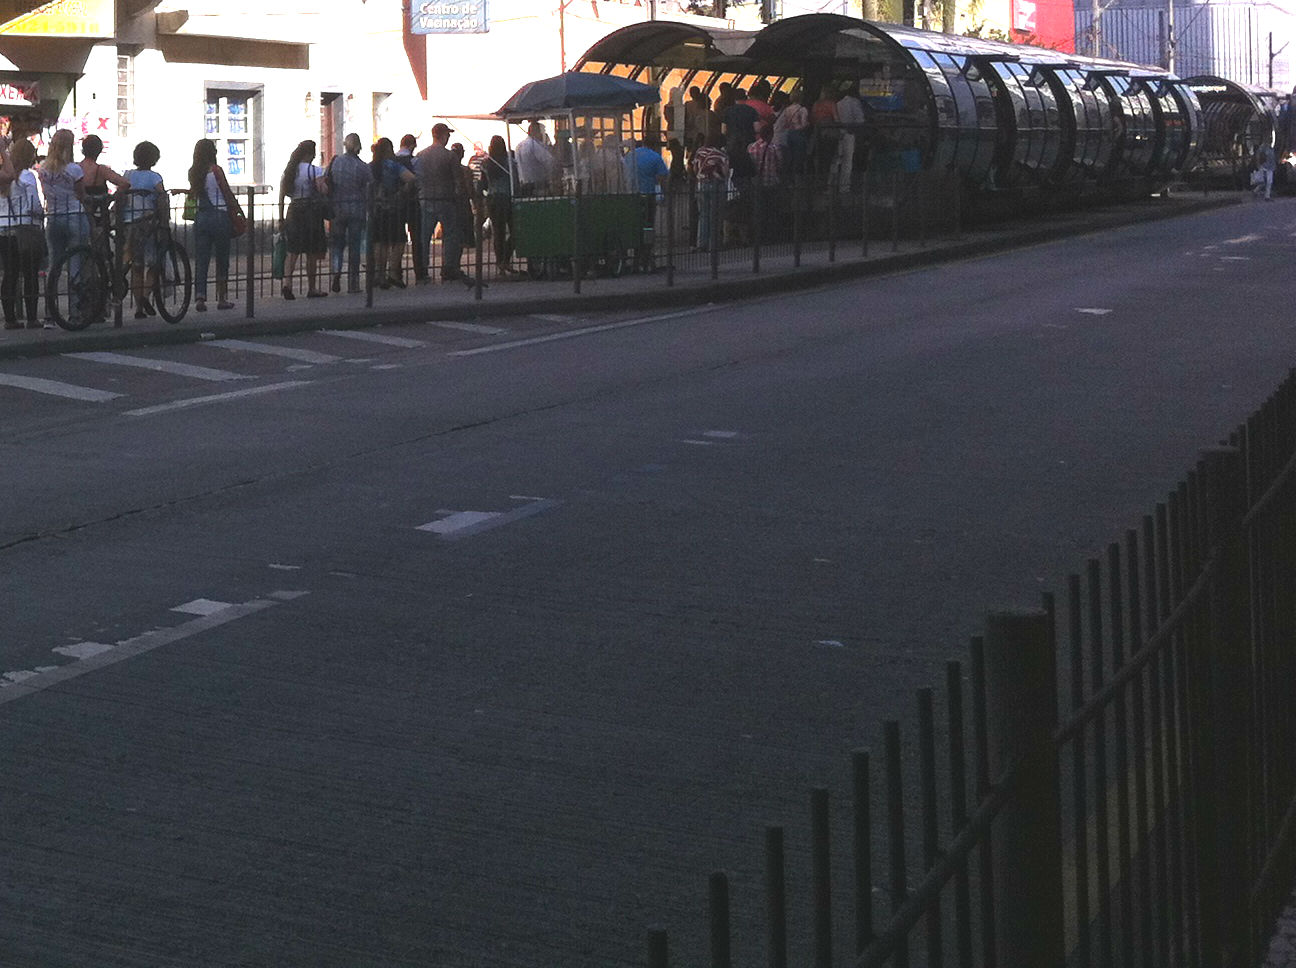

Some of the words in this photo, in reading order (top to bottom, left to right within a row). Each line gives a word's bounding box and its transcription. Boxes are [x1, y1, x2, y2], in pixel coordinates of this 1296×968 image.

[419, 2, 460, 16] Centro
[461, 2, 478, 15] de
[419, 16, 478, 31] Vacinação
